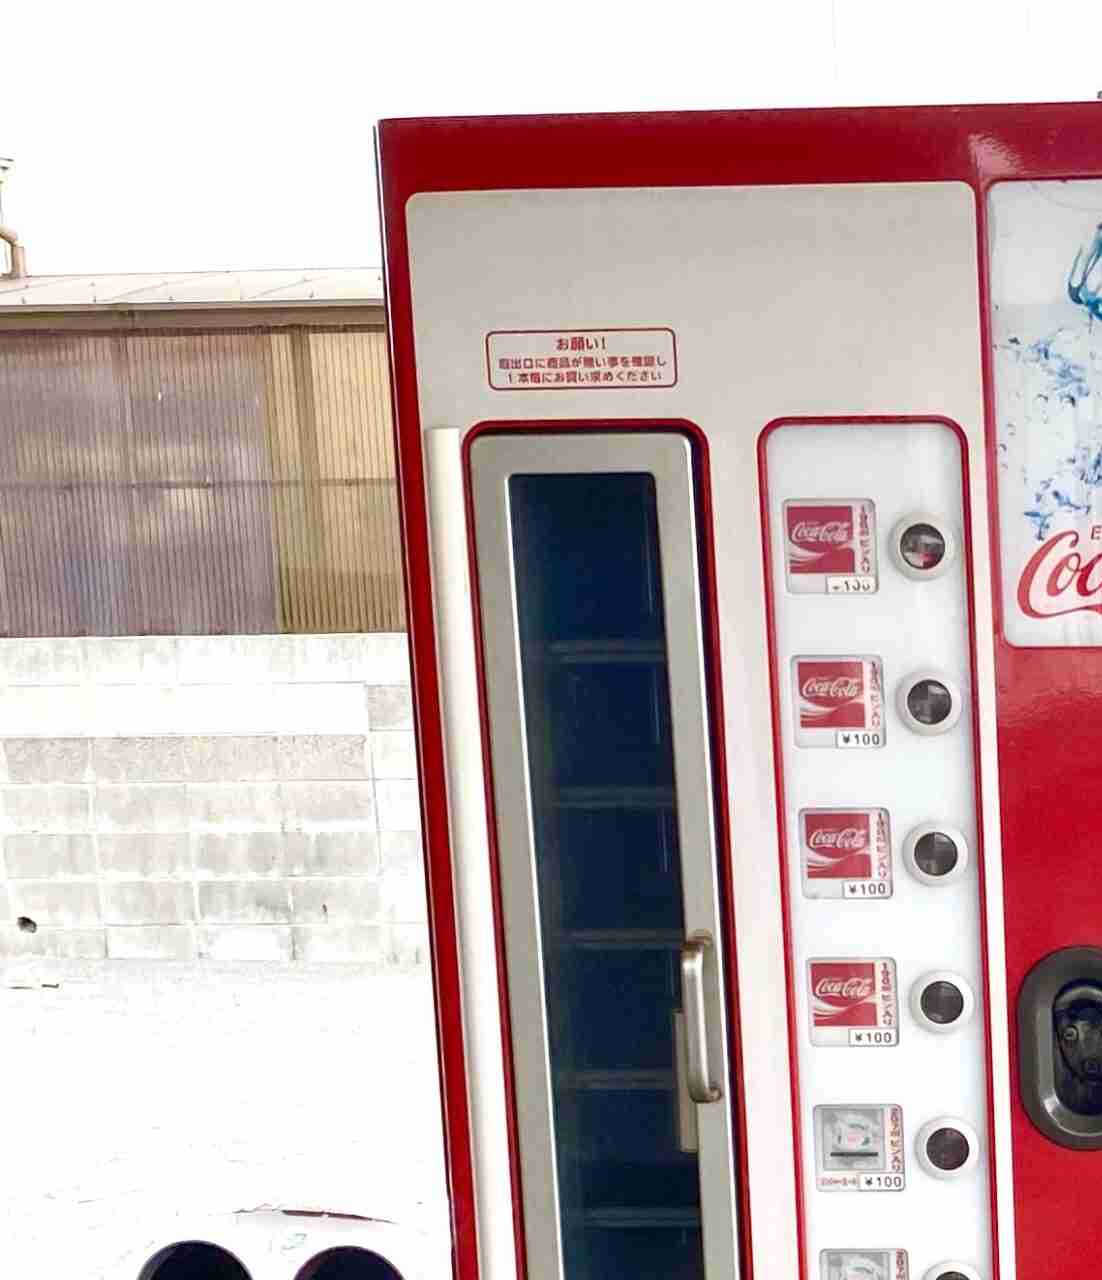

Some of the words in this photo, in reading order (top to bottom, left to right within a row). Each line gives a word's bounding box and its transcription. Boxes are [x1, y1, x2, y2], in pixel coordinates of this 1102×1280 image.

[802, 675, 862, 698] Coca-Cola
[842, 733, 880, 746] ¥100
[809, 828, 867, 849] Coca-Cola
[849, 882, 886, 895] ¥100
[814, 977, 873, 998] Coca-Cola
[855, 1032, 892, 1044] ¥100
[864, 1175, 902, 1188] ¥100
